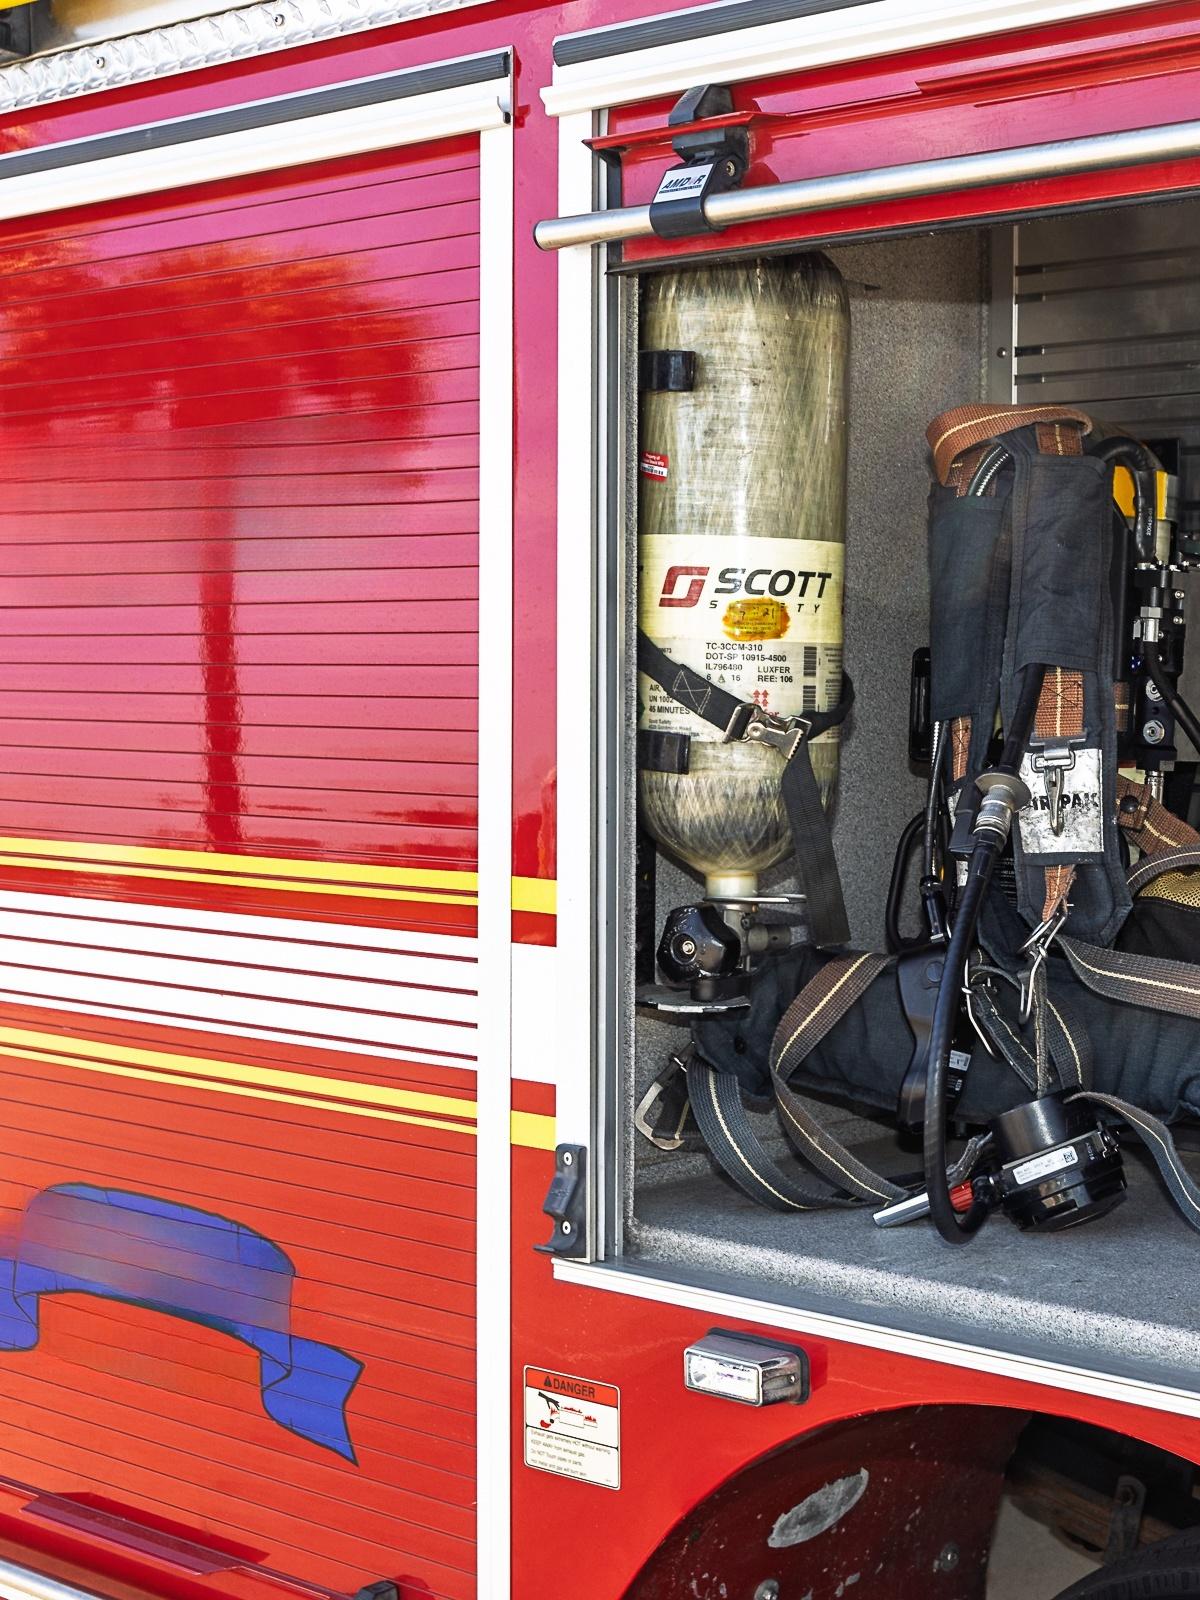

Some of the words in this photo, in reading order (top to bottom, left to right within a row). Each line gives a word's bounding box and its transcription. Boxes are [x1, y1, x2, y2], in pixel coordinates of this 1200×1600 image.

[662, 175, 706, 189] AMDR
[714, 567, 832, 598] SCOTT
[706, 642, 763, 652] TC-3CCM-310
[706, 653, 739, 661] DOT-SP
[742, 654, 787, 662] 10915-4500
[758, 666, 790, 674] LUXFER
[706, 673, 712, 681] 6
[757, 675, 778, 683] REE:
[657, 706, 691, 715] MINUTES
[553, 1378, 595, 1398] DANGER
